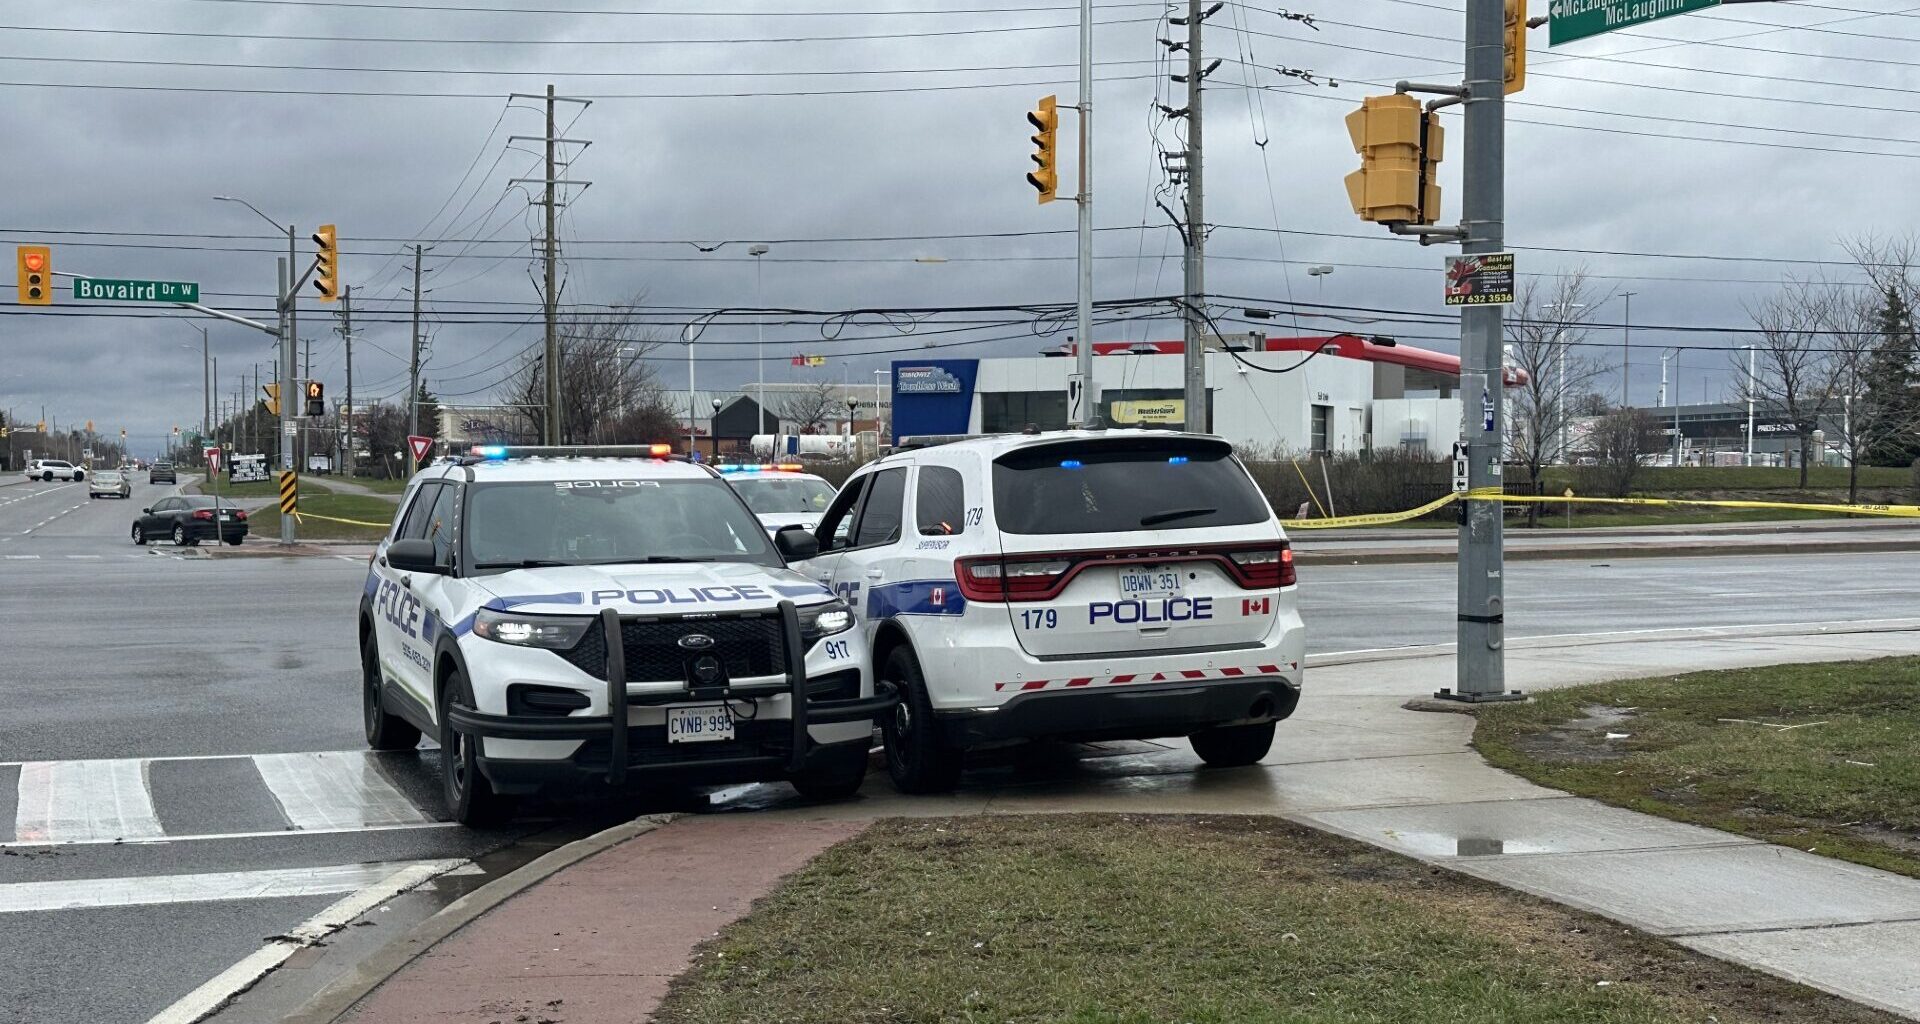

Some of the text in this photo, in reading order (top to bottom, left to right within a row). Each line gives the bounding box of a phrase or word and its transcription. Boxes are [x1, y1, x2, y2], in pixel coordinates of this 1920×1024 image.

[80, 280, 192, 299] Bovaird Dr W
[1446, 293, 1512, 304] 647 632 3536
[966, 507, 983, 527] 179
[1158, 573, 1180, 590] 351
[592, 585, 773, 605] POLICE
[378, 579, 421, 639] POLICE
[1089, 597, 1213, 625] POLICE
[1021, 609, 1057, 630] 179
[825, 640, 850, 660] 917
